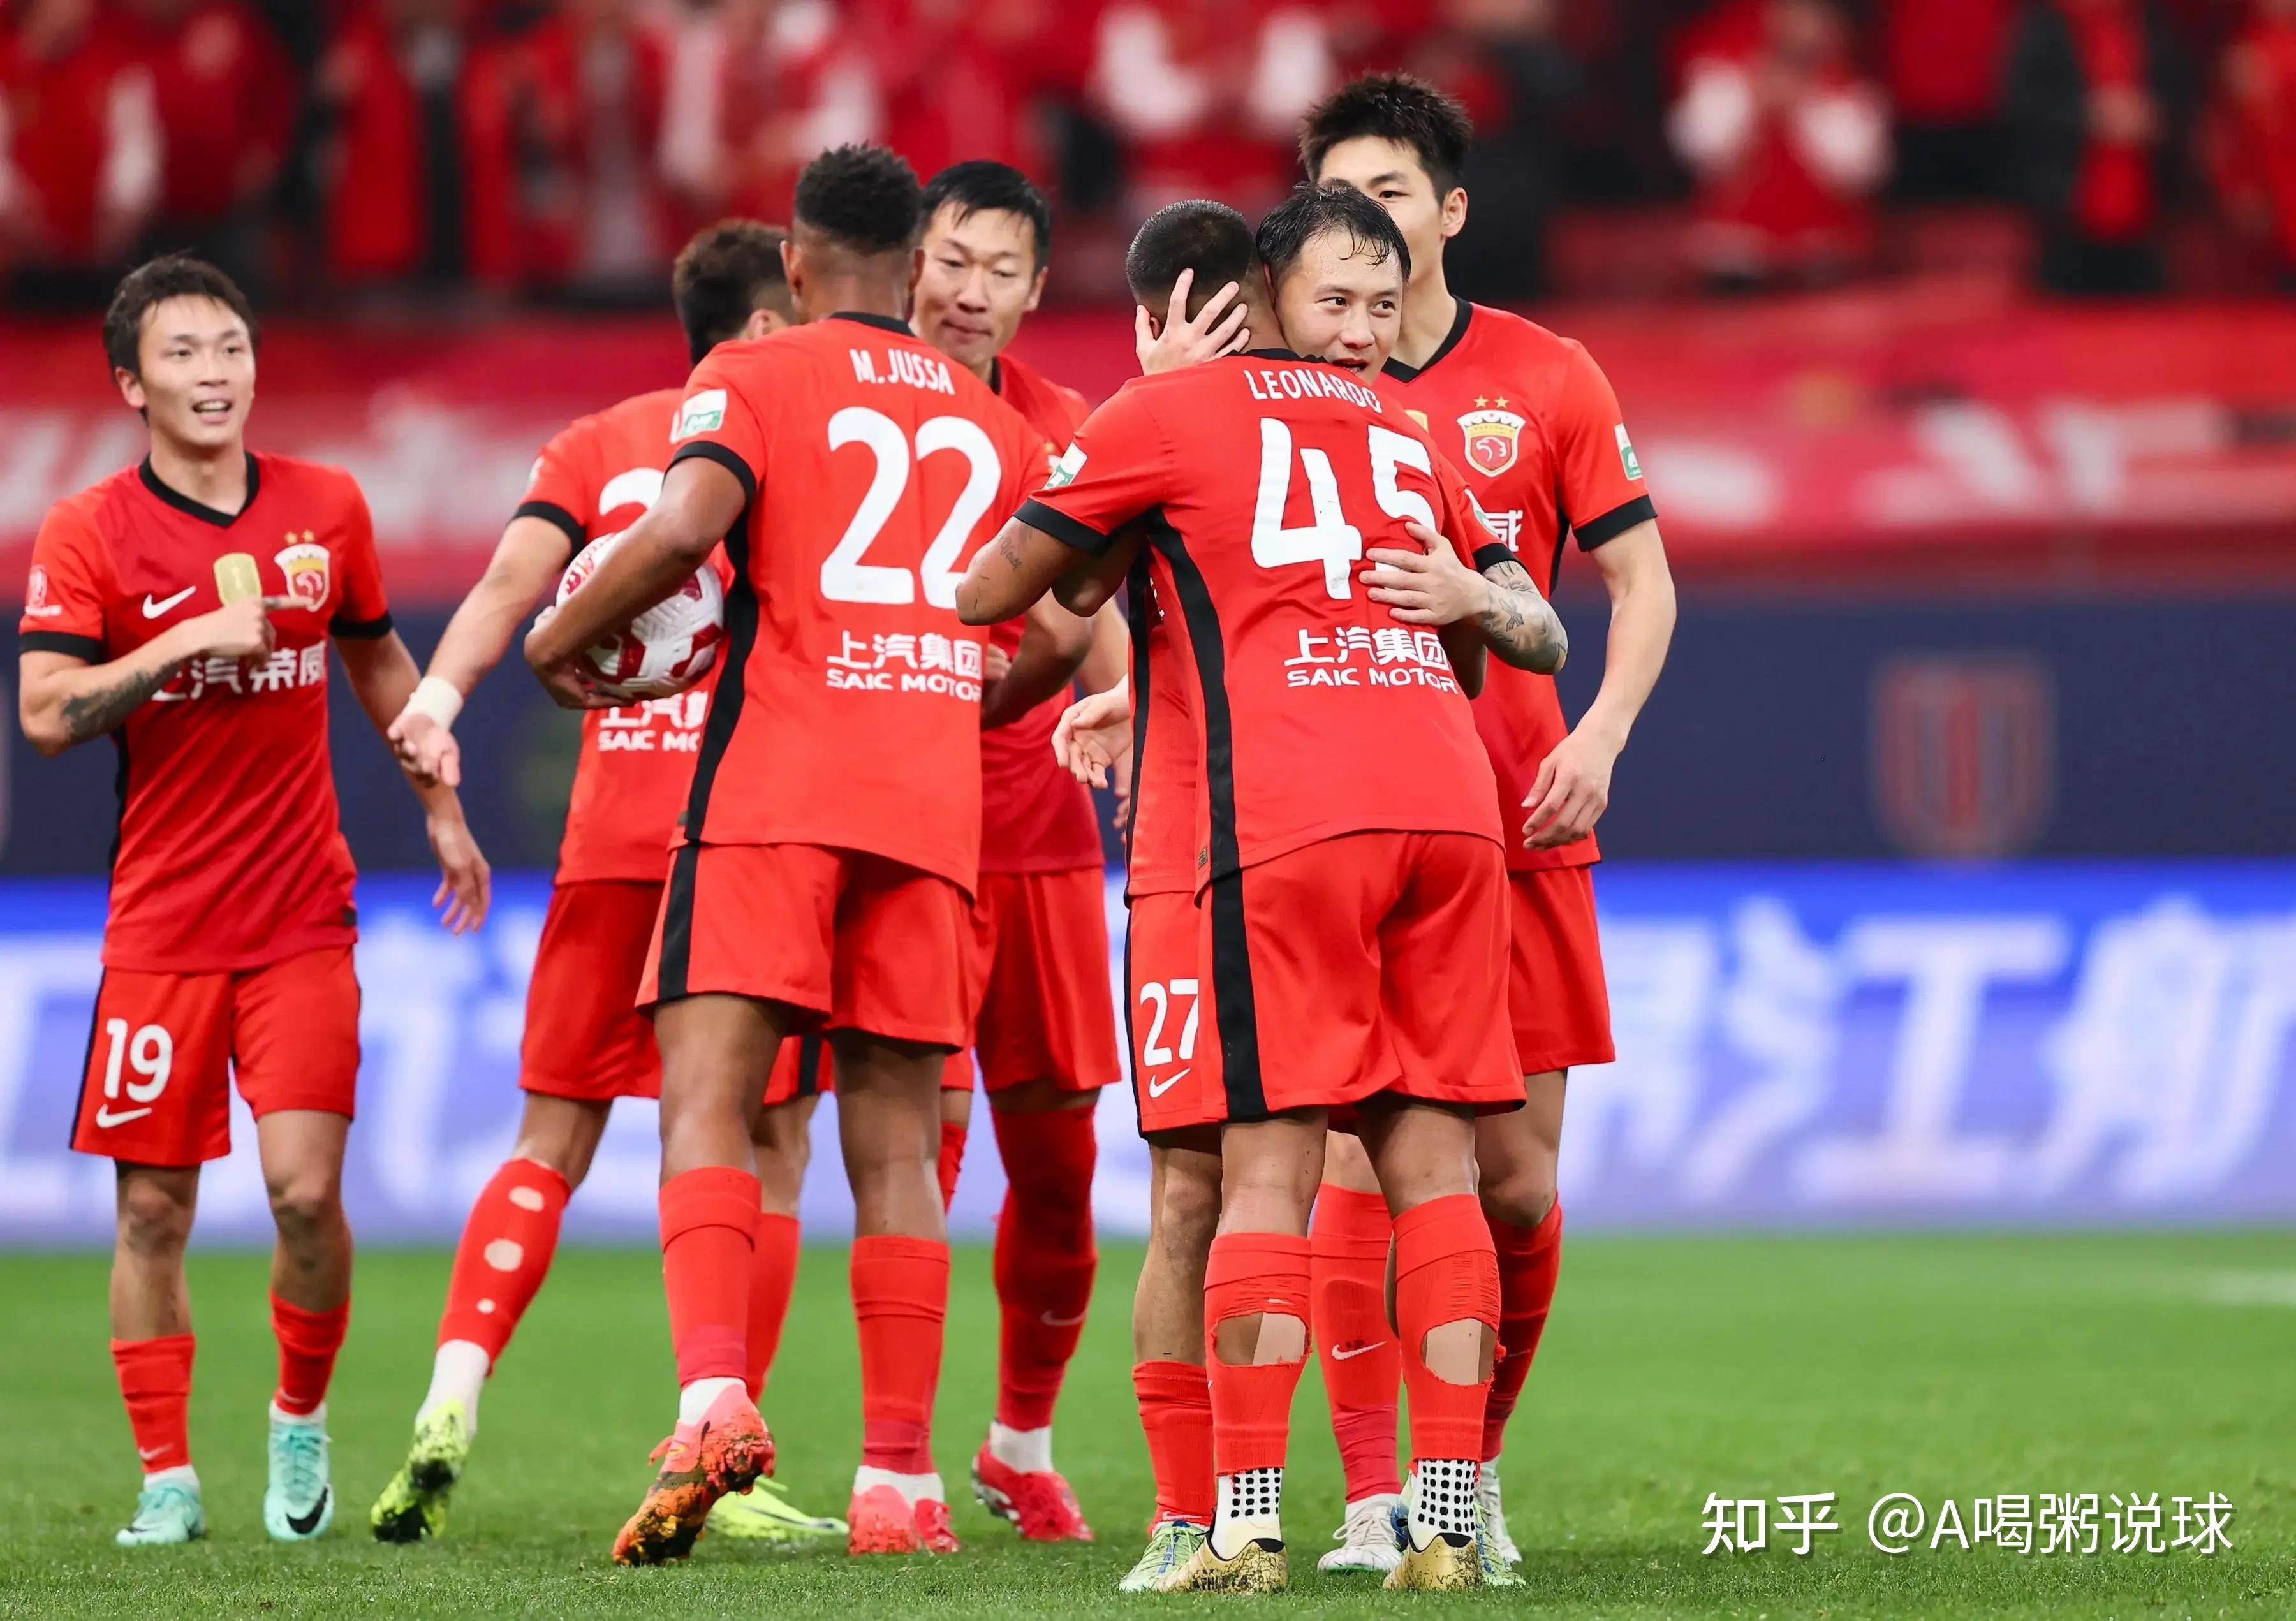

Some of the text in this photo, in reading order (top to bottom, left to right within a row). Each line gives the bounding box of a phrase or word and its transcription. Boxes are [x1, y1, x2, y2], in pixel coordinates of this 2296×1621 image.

[1243, 369, 1383, 414] LEONARDO
[821, 406, 1001, 609] 22
[1251, 417, 1436, 600] 45
[826, 630, 982, 680] 上汽集团
[1284, 626, 1450, 671] 上汽集团
[826, 668, 893, 690] SAIC
[1286, 668, 1459, 694] SAIC MOTOR
[598, 730, 656, 752] SAIC
[1140, 978, 1199, 1067] 27
[104, 1018, 172, 1102] 19
